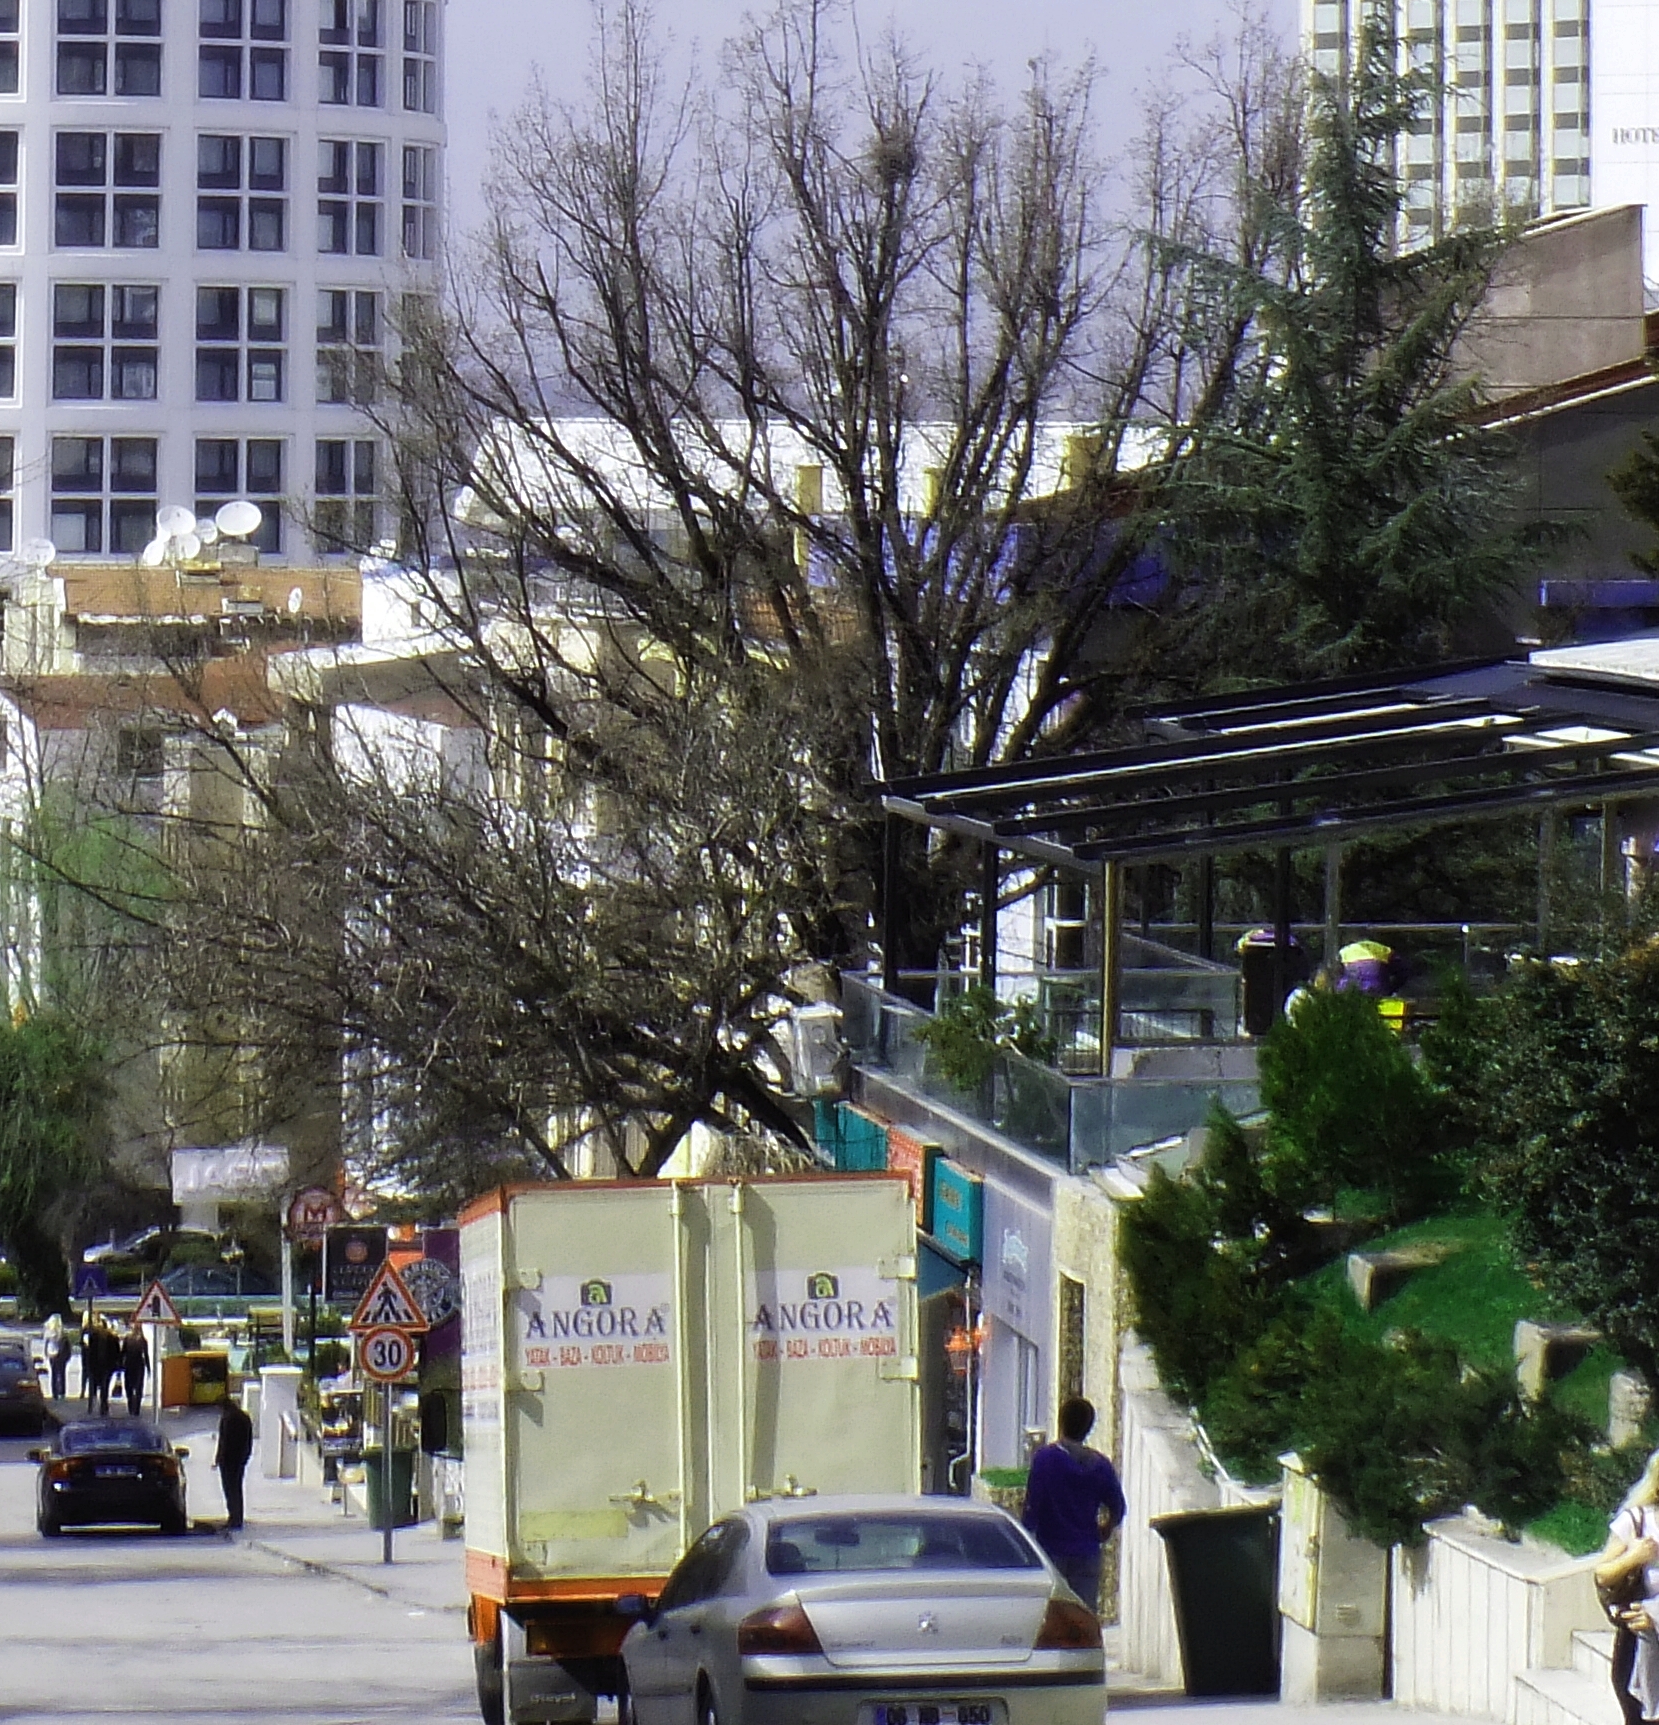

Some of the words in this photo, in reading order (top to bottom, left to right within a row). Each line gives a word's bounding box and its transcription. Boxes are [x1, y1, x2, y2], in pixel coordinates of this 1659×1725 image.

[526, 1307, 666, 1339] ANGORA
[753, 1300, 894, 1331] ANGORA
[374, 1339, 402, 1368] 30
